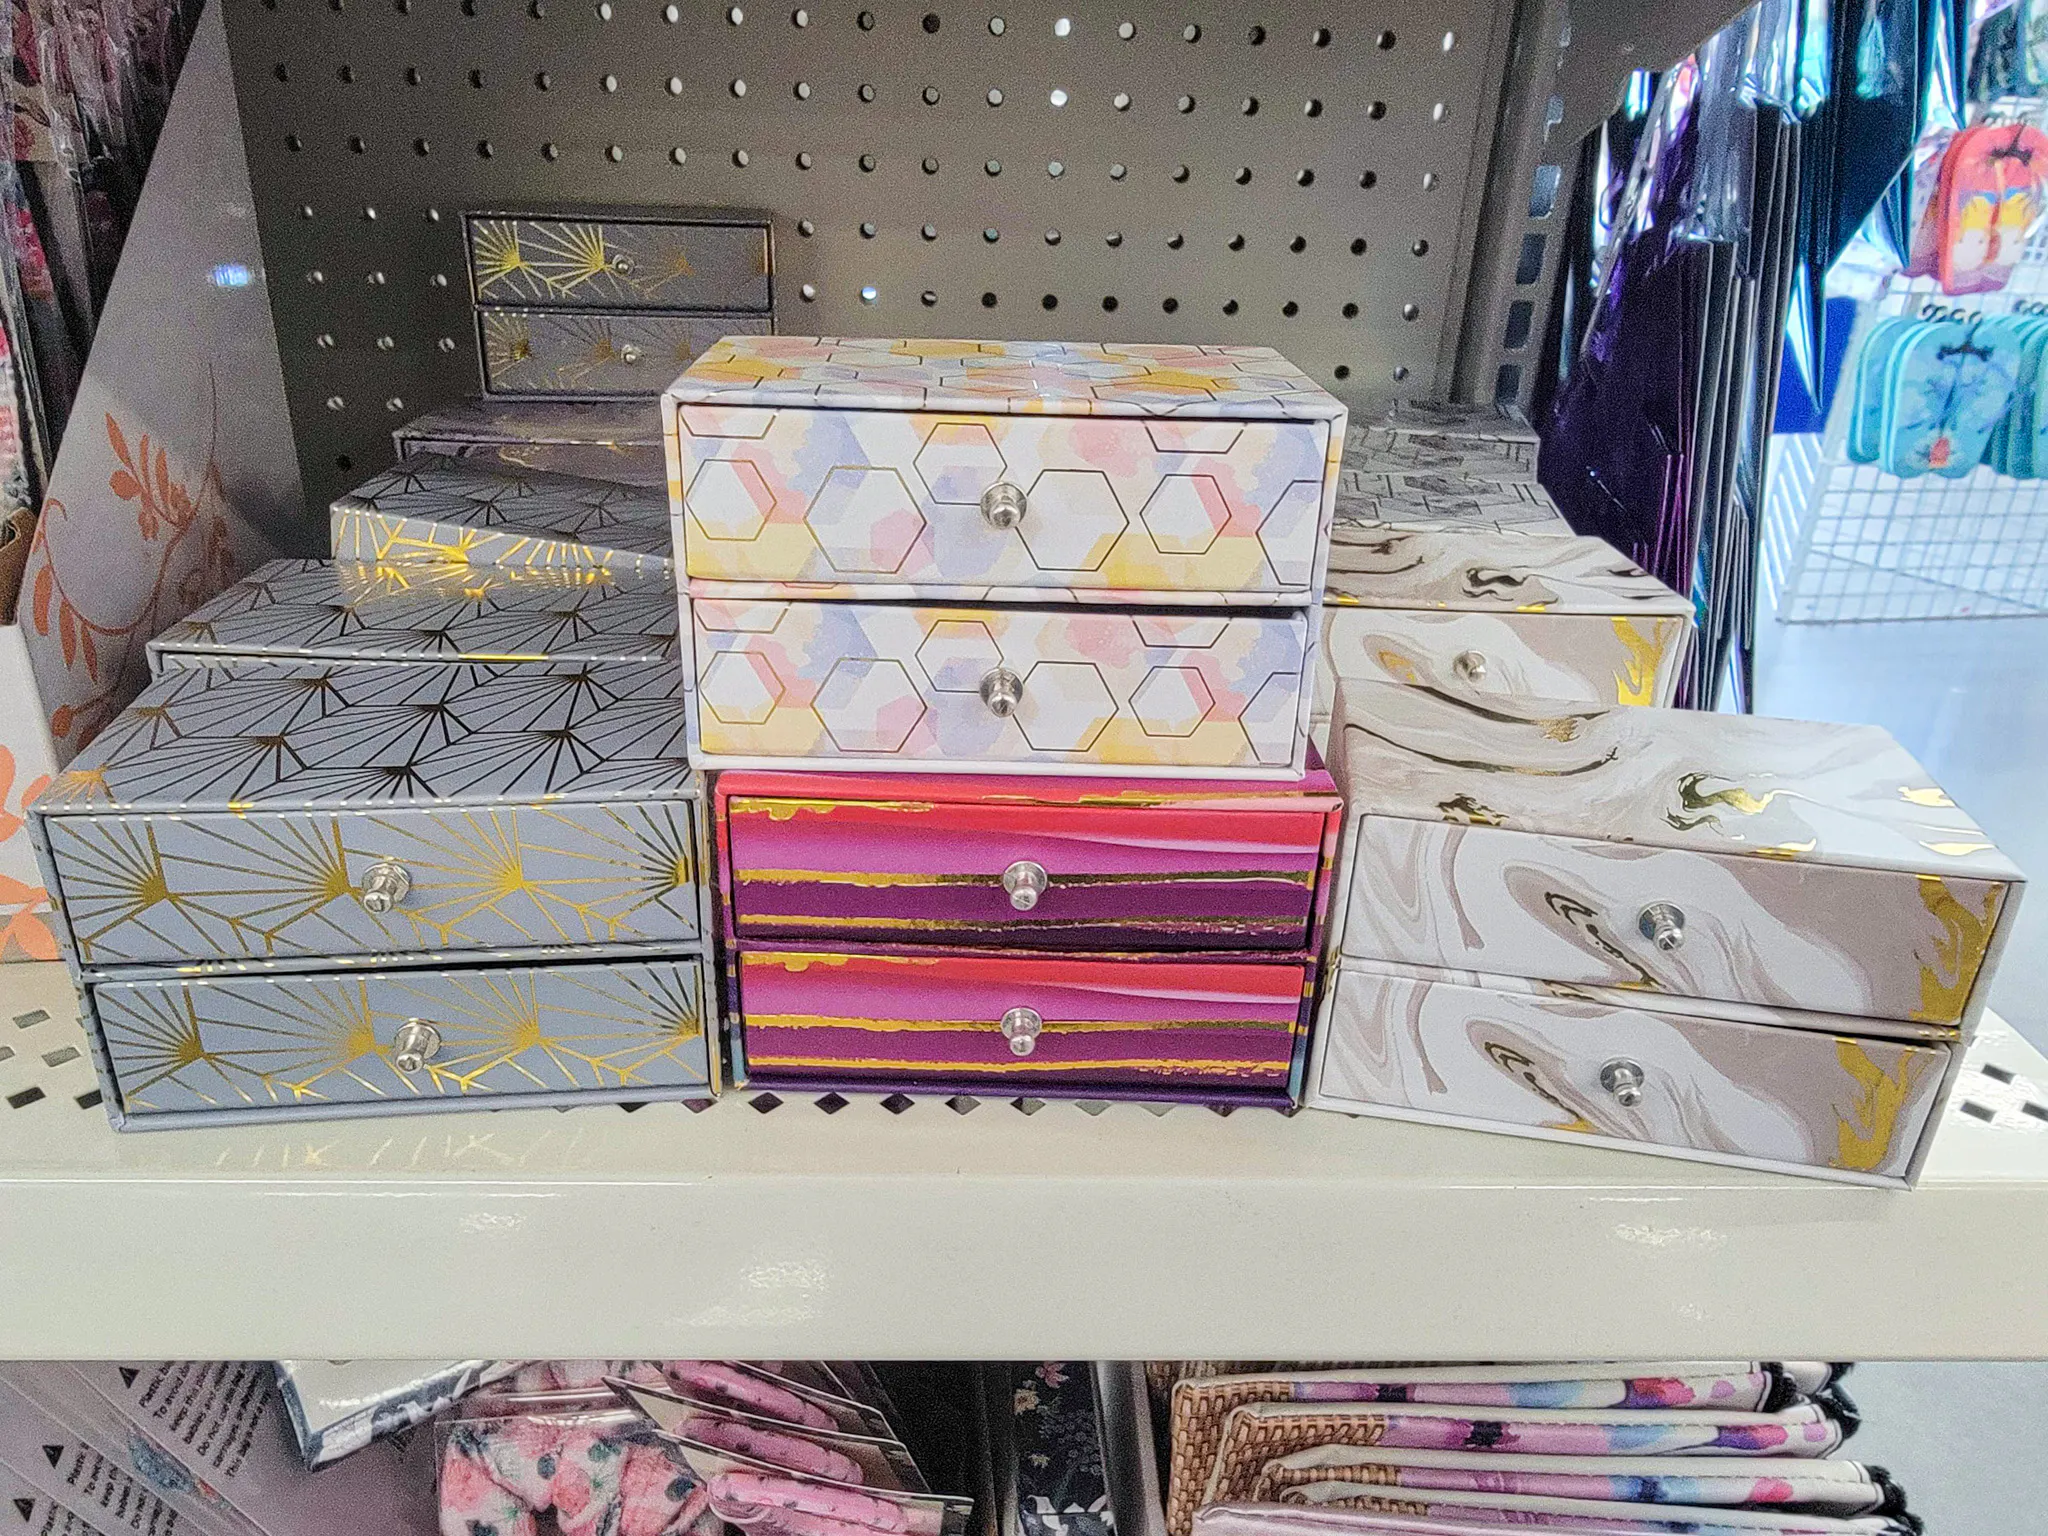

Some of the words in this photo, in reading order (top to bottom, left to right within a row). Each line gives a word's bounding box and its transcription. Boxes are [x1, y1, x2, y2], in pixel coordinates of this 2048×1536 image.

[139, 1375, 164, 1408] Plastic
[153, 1405, 168, 1419] To
[183, 1412, 206, 1444] babies
[197, 1441, 210, 1456] Do
[207, 1421, 220, 1440] not
[223, 1458, 243, 1478] This
[130, 1513, 143, 1530] Do
